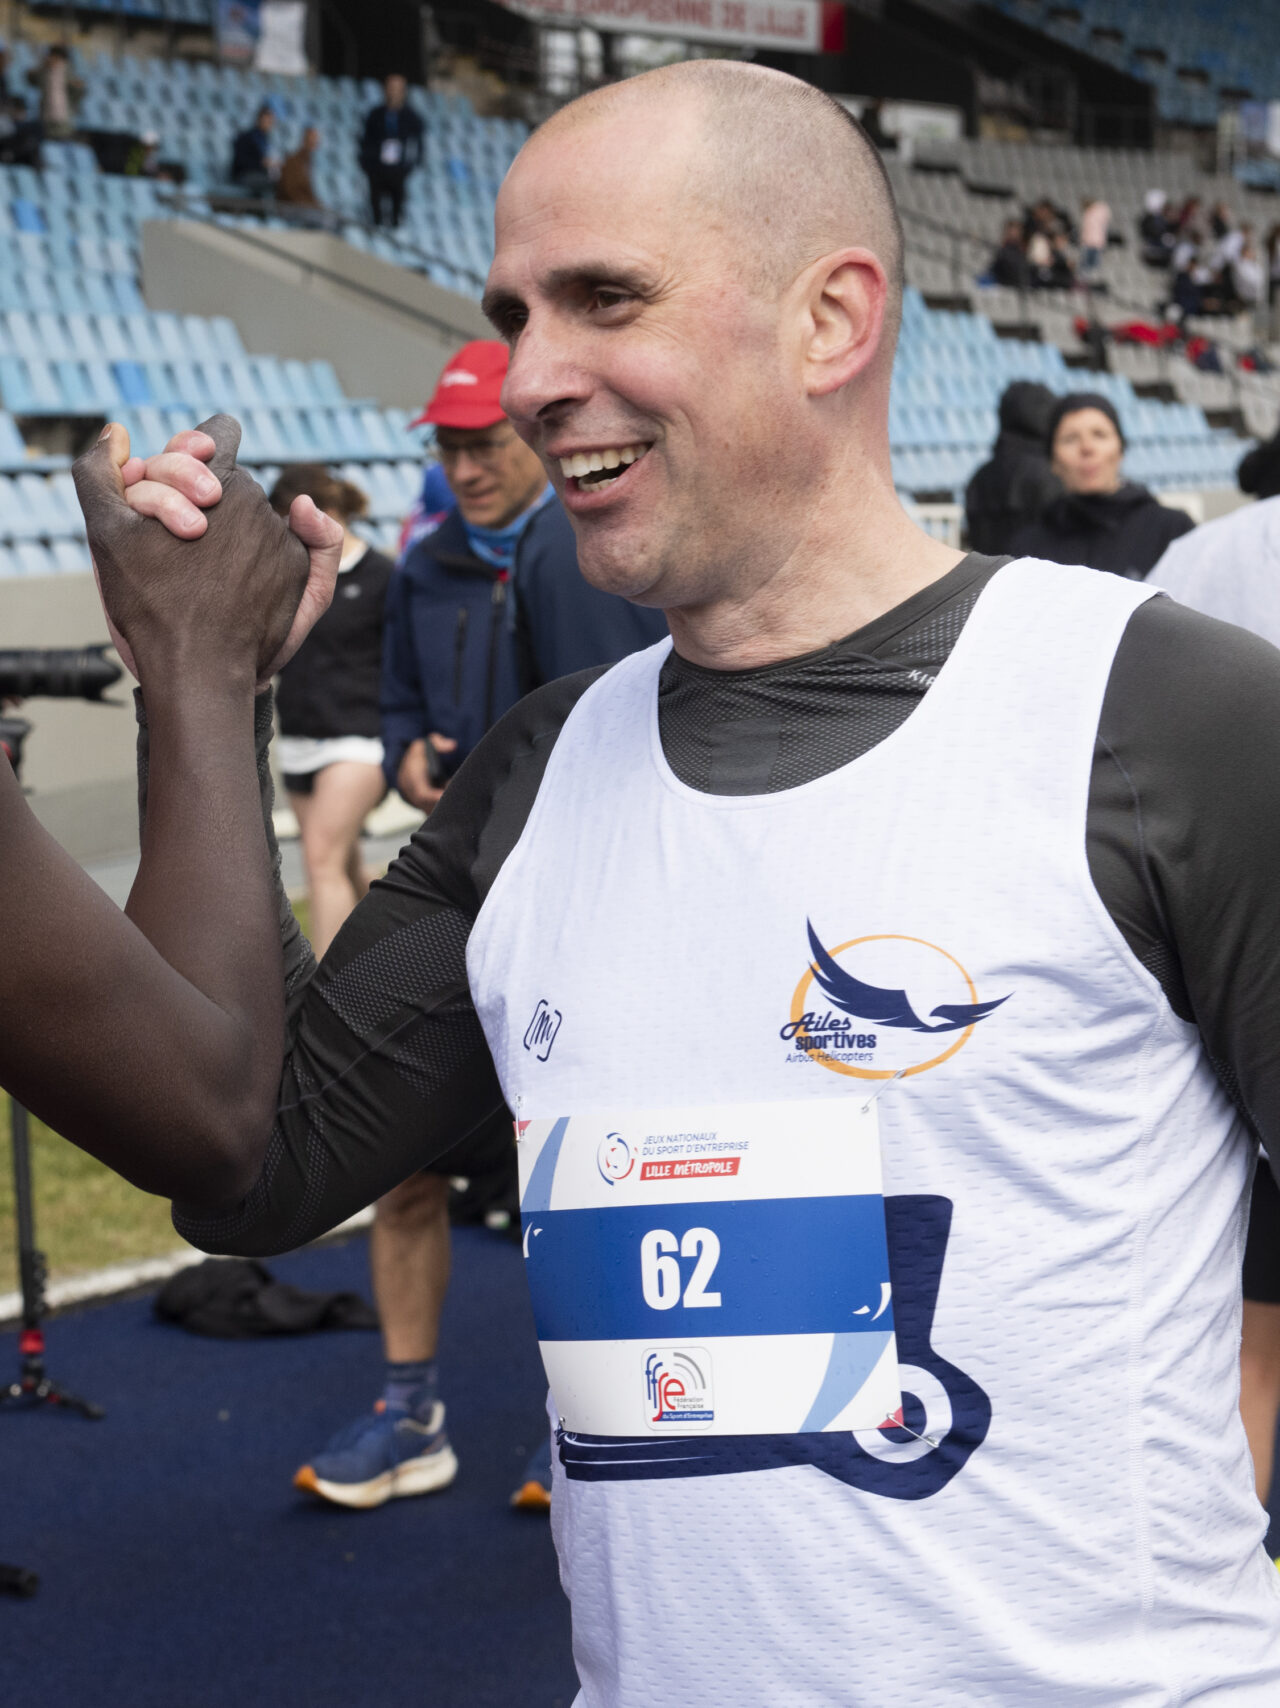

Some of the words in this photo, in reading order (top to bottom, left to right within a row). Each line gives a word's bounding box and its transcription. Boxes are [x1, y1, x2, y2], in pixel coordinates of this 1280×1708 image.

[779, 1010, 852, 1041] Ailes
[795, 1031, 877, 1052] sportives
[784, 1052, 815, 1063] Airbus
[643, 1135, 664, 1145] JEUX
[666, 1132, 718, 1143] NATIONAUX
[642, 1147, 655, 1156] DU
[656, 1145, 684, 1155] SPORT
[686, 1141, 749, 1153] D'ENTREPRISE
[645, 1165, 672, 1178] LILLE
[673, 1160, 734, 1176] MÉTROPOLE
[640, 1227, 722, 1311] 62
